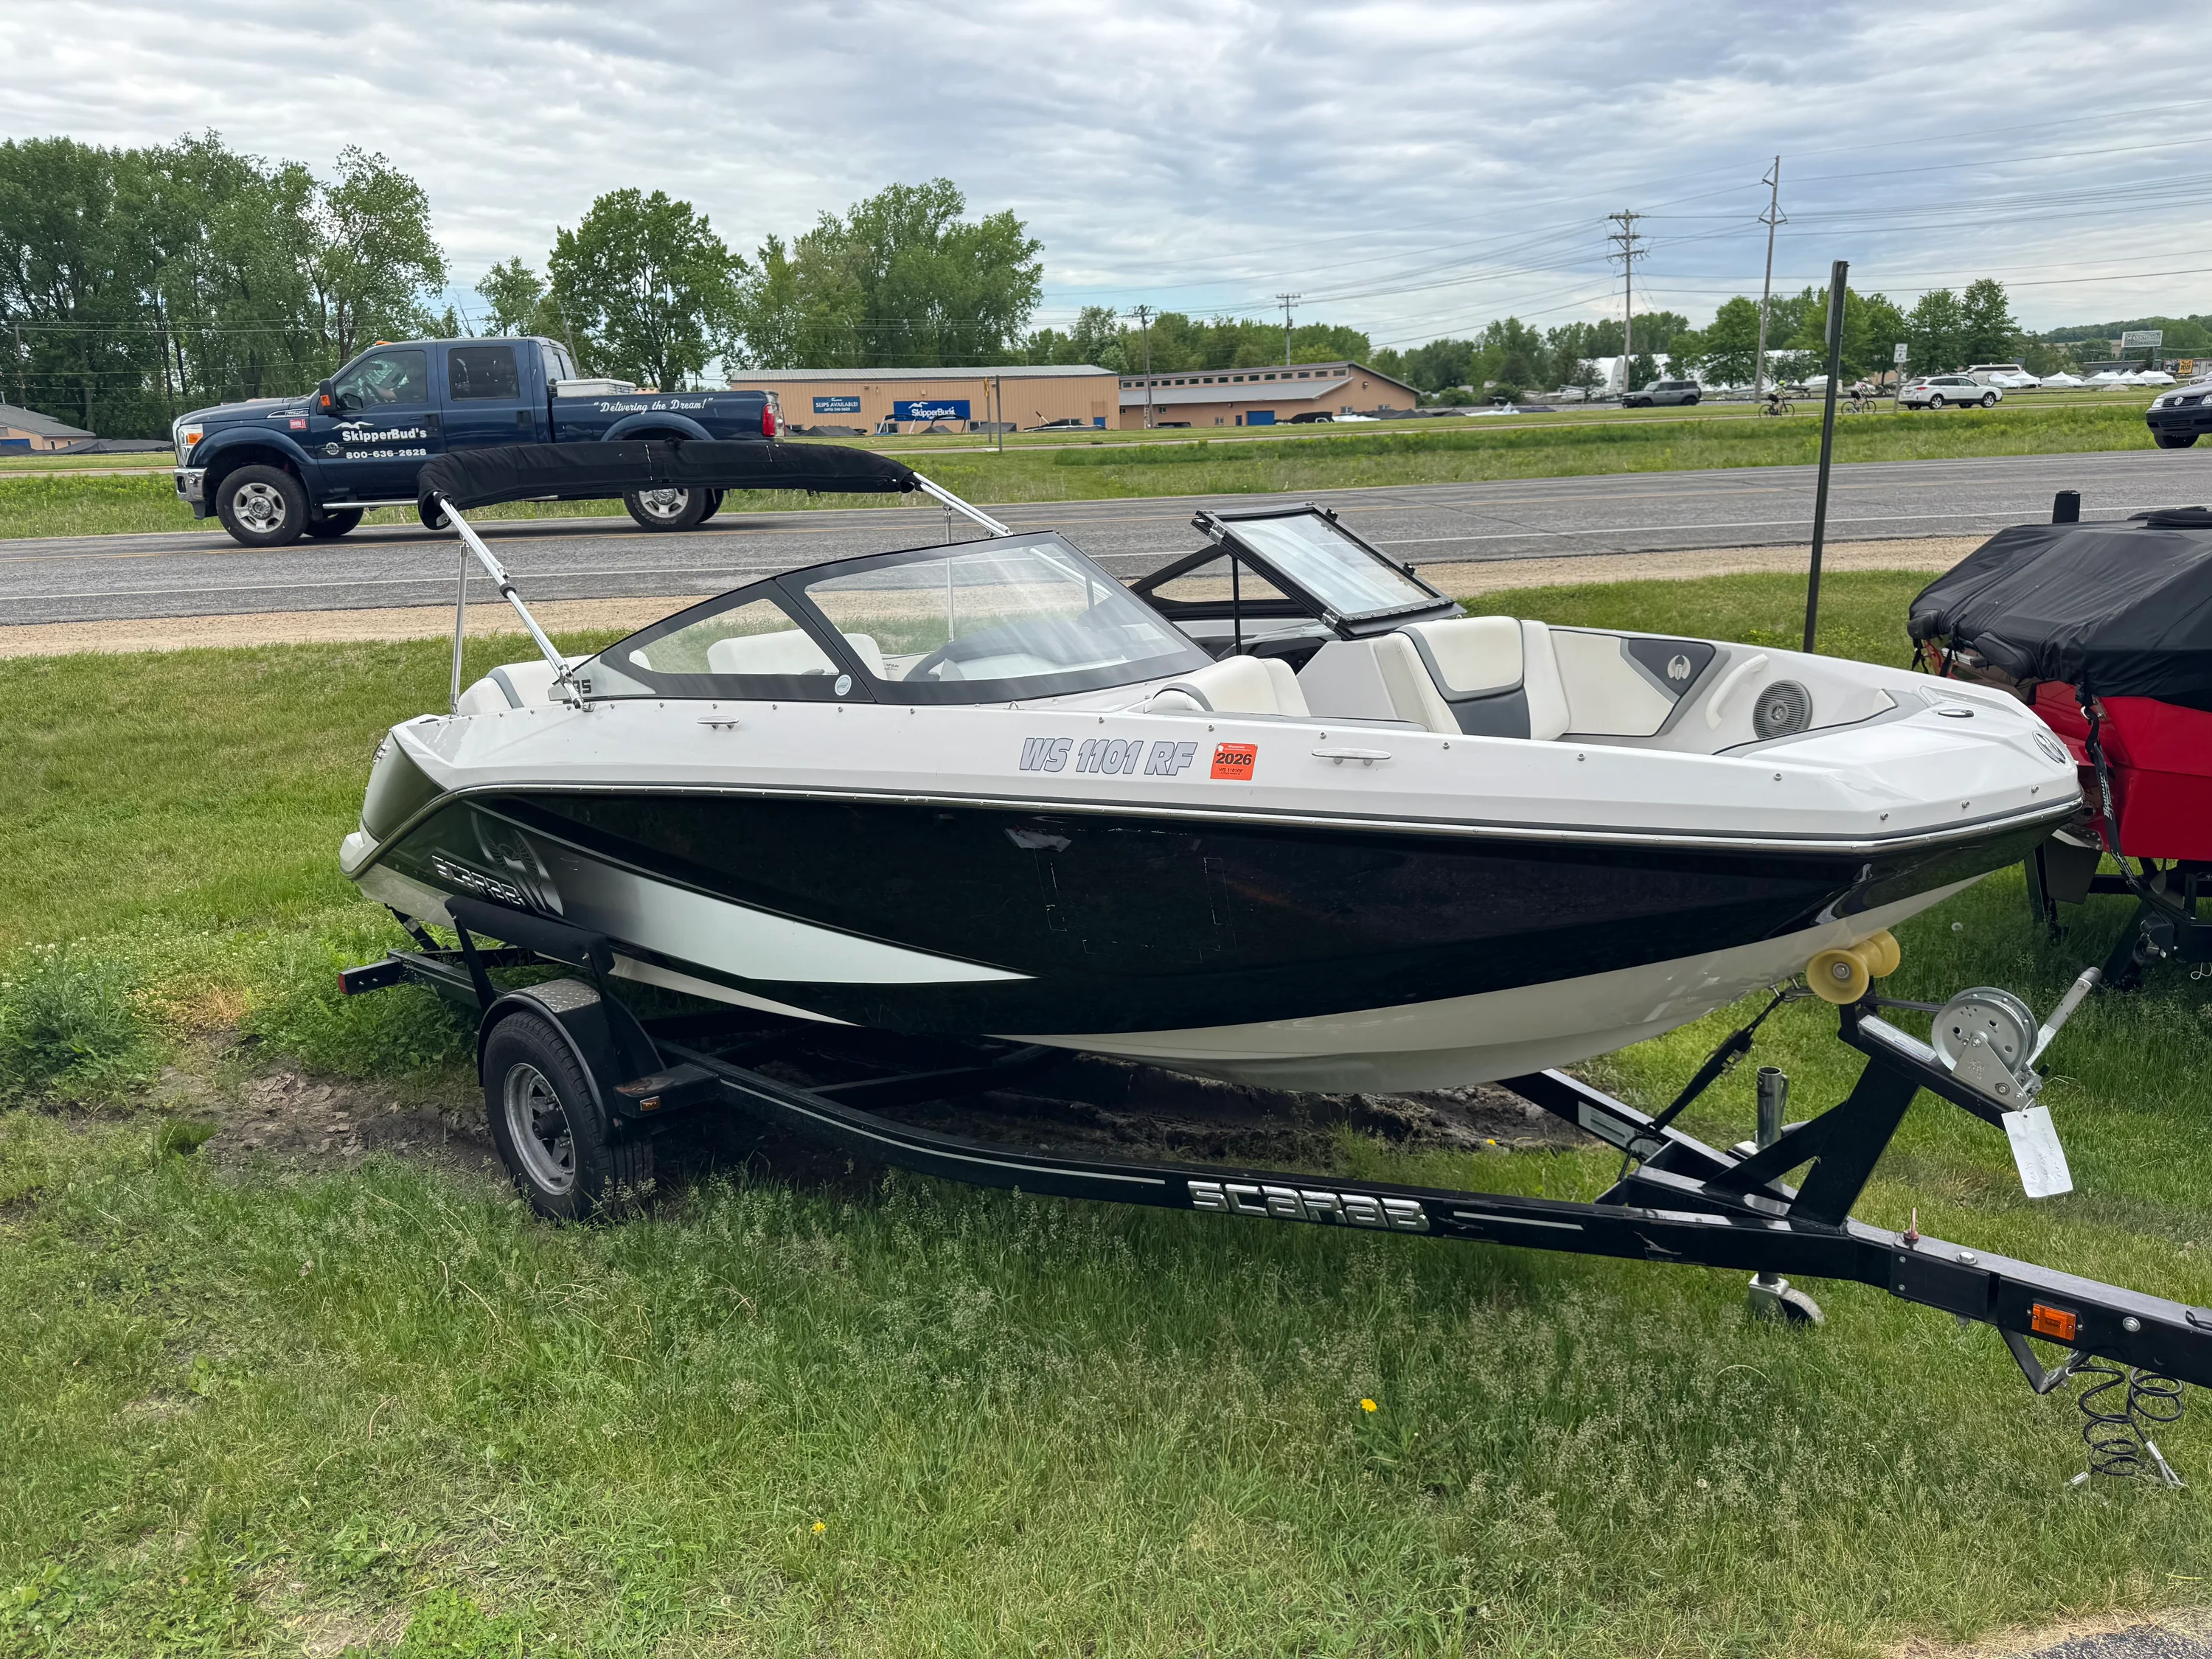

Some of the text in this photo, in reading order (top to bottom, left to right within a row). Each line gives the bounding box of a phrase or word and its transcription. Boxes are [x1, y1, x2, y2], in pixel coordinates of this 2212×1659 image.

[652, 400, 667, 410] the
[342, 428, 427, 442] SkipperBud's
[346, 448, 427, 459] 800-636-2628
[1019, 737, 1198, 776] WS 1101 RF
[1214, 752, 1253, 765] 2026
[1187, 1180, 1430, 1232] SCARAB
